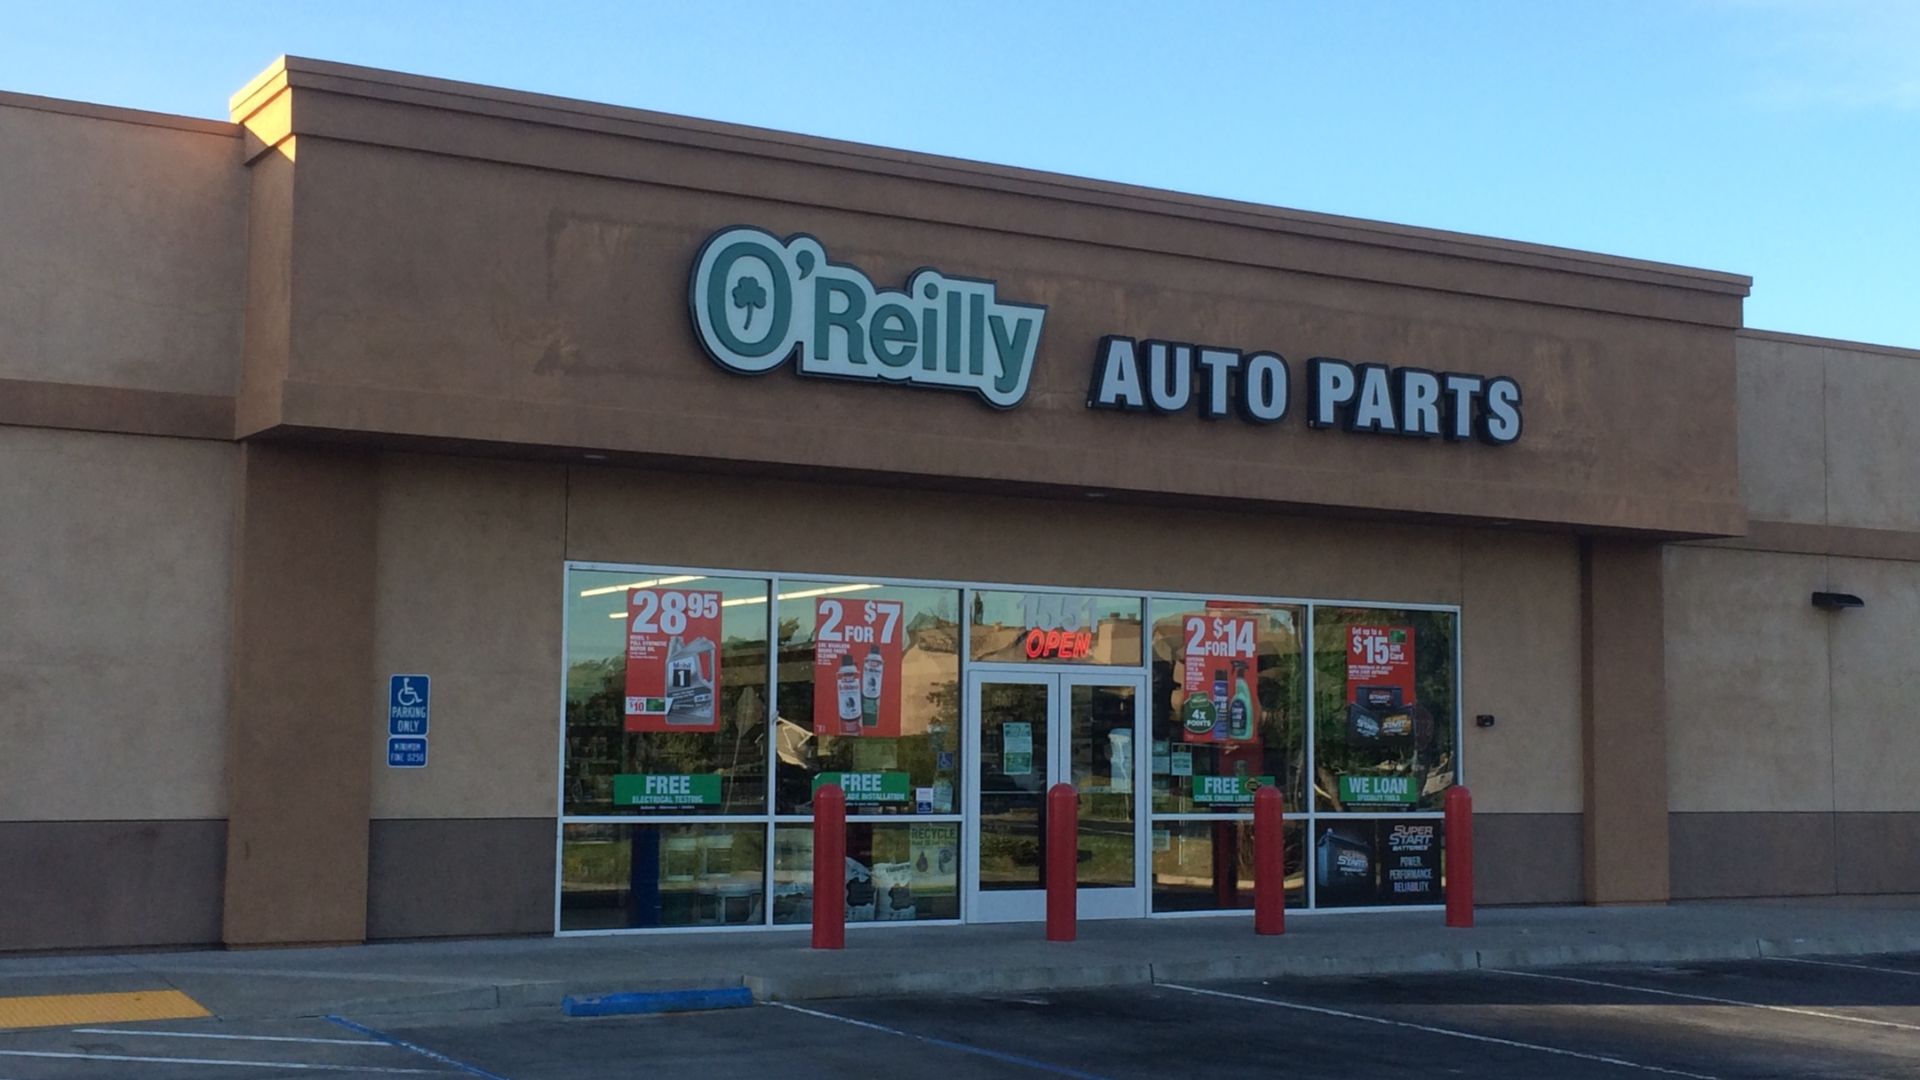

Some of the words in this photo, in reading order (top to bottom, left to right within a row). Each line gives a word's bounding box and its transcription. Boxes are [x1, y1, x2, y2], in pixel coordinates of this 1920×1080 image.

[706, 240, 1034, 394] O'Reilly
[1098, 338, 1288, 421] AUTO
[1318, 360, 1521, 441] PARTS
[817, 599, 843, 641] 2
[845, 626, 874, 642] FOR
[1026, 628, 1092, 657] OPEN
[1186, 617, 1206, 655] 2
[1206, 641, 1228, 656] FOR
[1353, 634, 1389, 665] $15
[678, 670, 685, 687] 1
[392, 706, 427, 719] PARKING
[397, 720, 420, 732] ONLY
[645, 775, 690, 795] FREE
[841, 774, 882, 791] FREE
[1205, 777, 1239, 794] FREE
[1349, 777, 1369, 793] WE
[1374, 778, 1408, 794] LOAN
[912, 828, 955, 840] RECYCLE
[1388, 833, 1433, 845] START
[1394, 825, 1433, 836] SUPER
